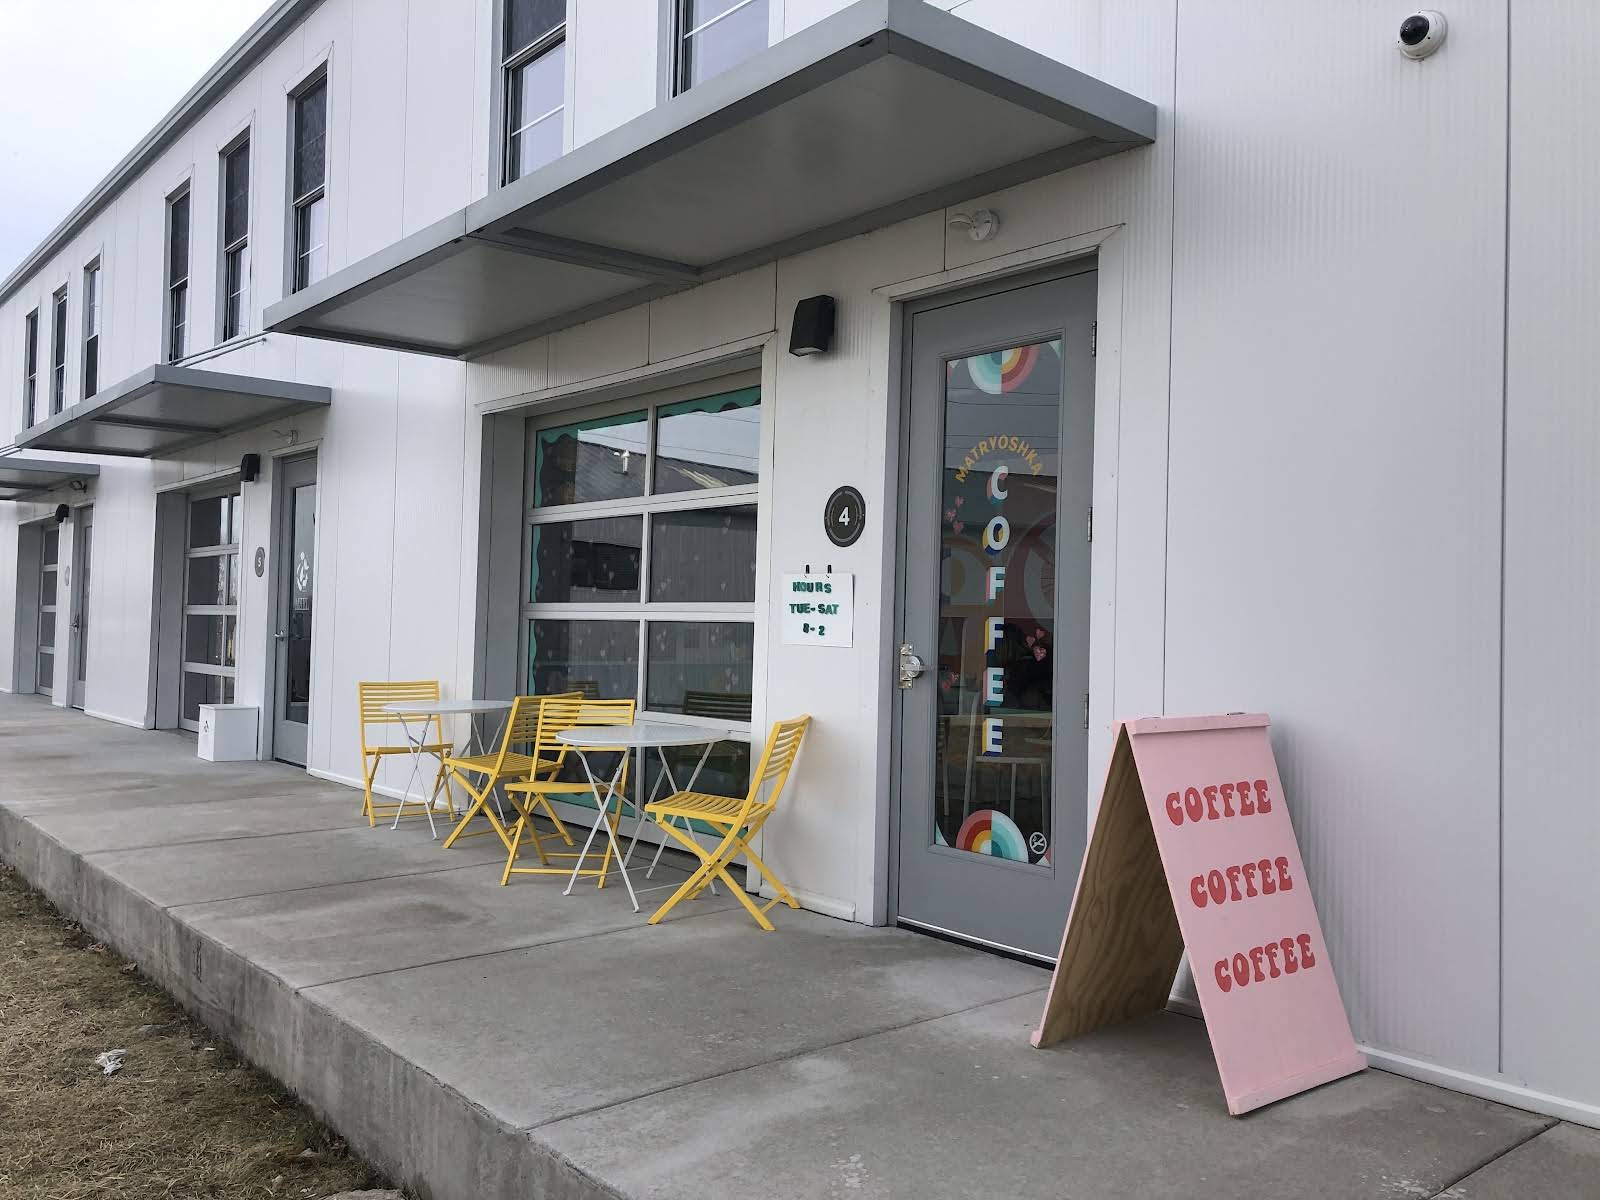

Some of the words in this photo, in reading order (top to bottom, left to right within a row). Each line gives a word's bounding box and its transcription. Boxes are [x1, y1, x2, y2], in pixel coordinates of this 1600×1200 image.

[955, 434, 1043, 483] MATRYOSHKA
[839, 506, 850, 526] 4
[792, 581, 832, 594] HOURS
[982, 465, 1011, 757] COFFEE
[1165, 779, 1272, 826] COFFEE
[1190, 856, 1293, 908] COFFEE
[1214, 933, 1316, 993] COFFEE
